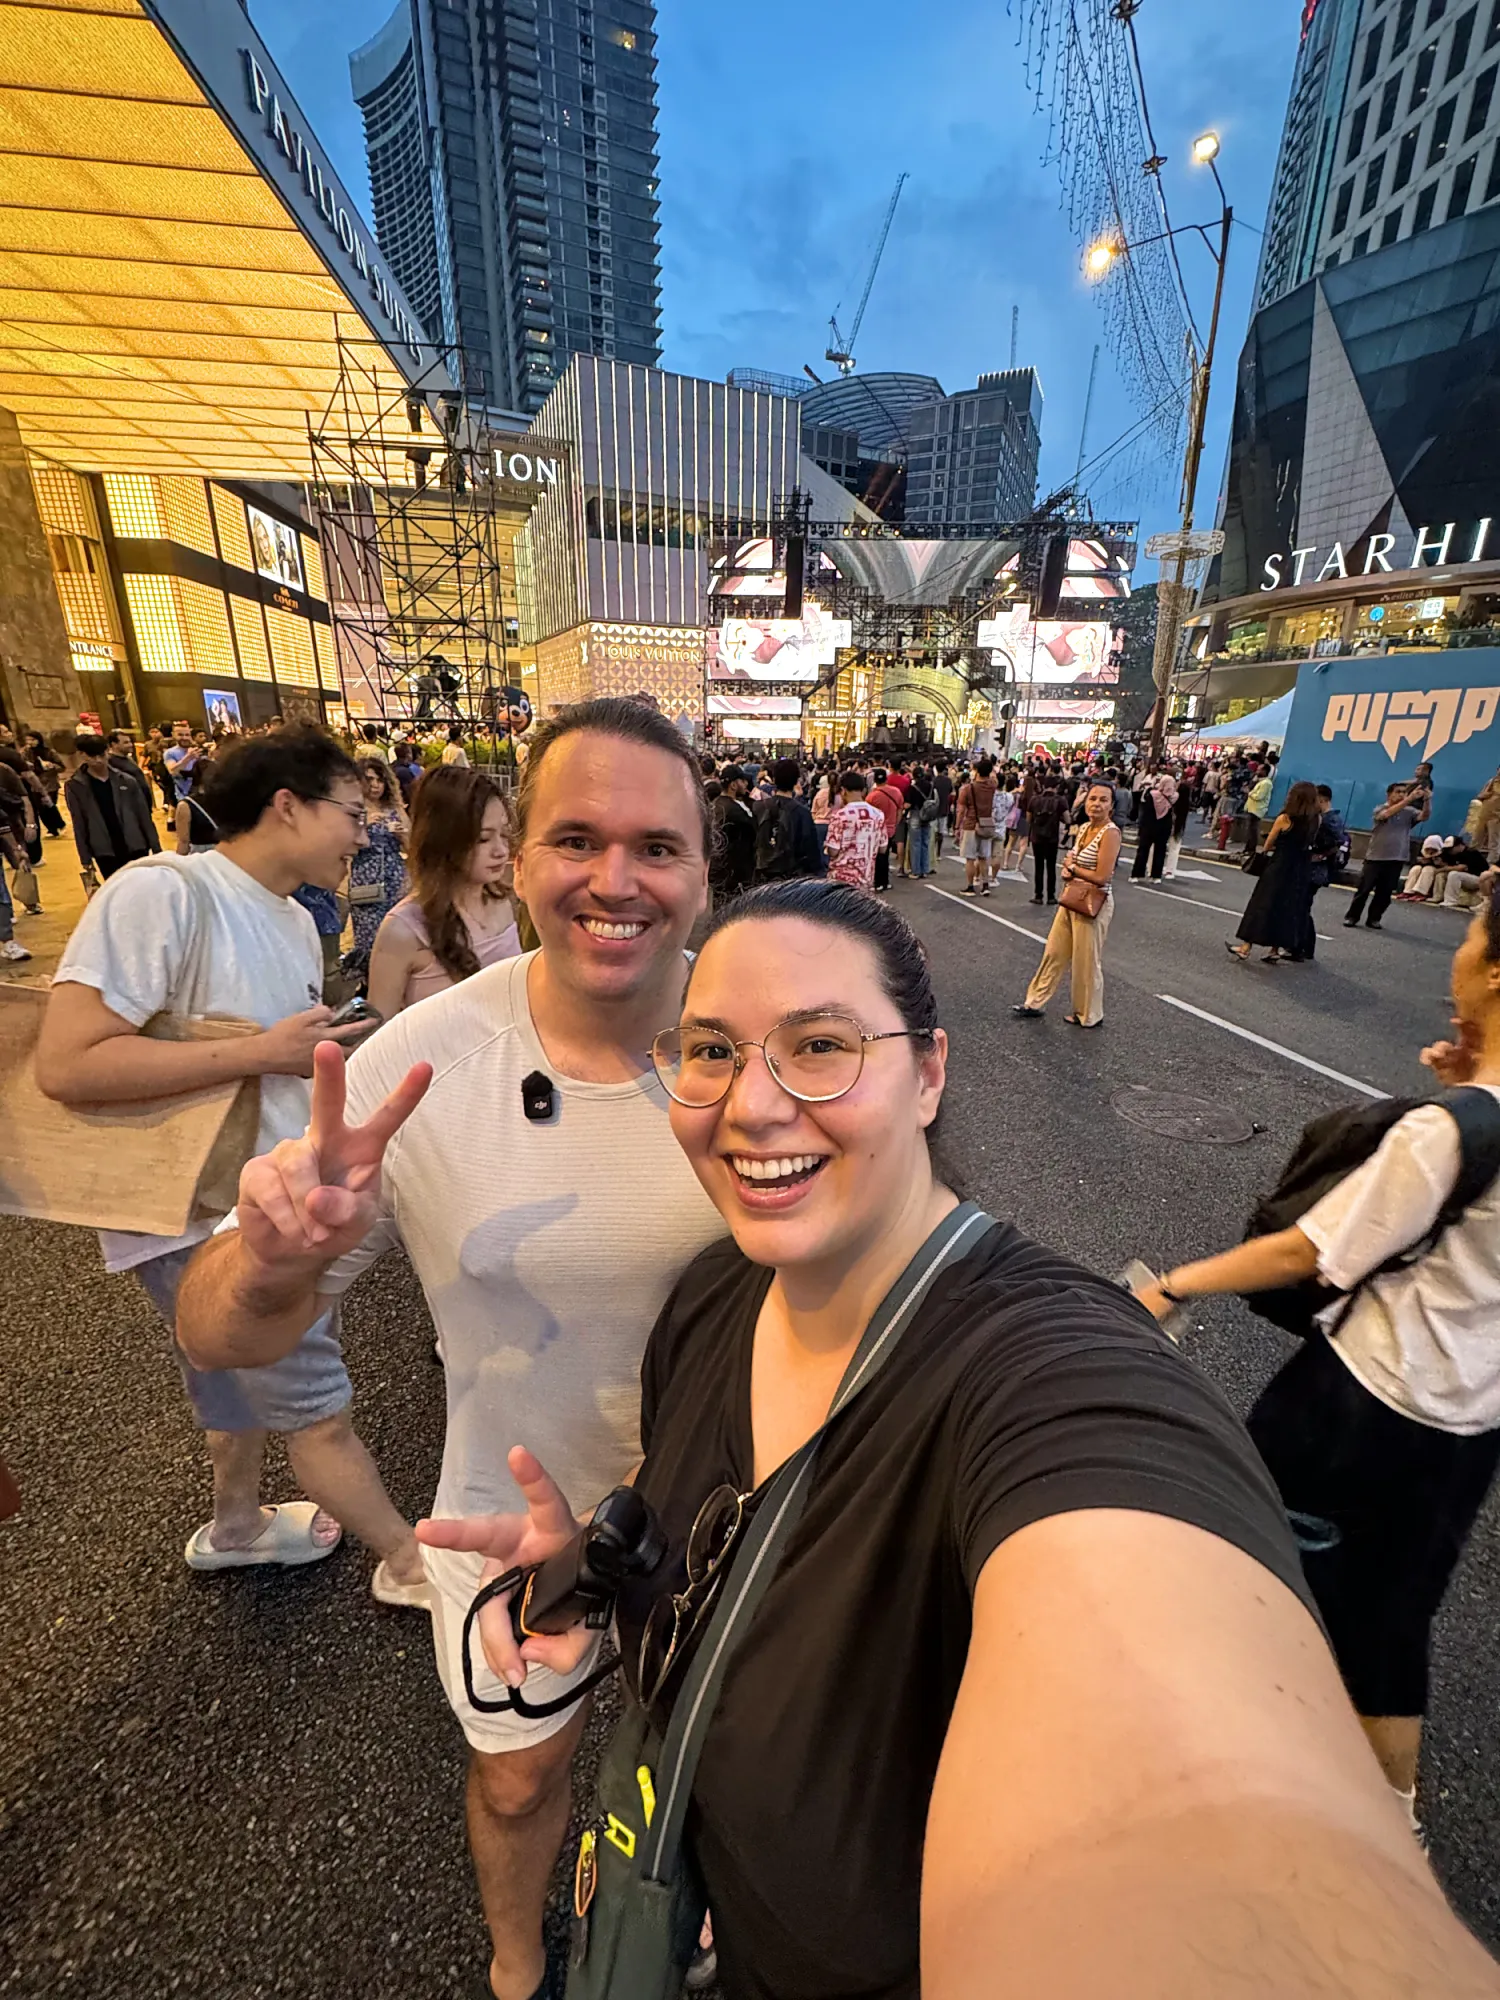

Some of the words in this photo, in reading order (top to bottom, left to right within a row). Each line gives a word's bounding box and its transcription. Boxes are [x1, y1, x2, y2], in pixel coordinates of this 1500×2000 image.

[245, 48, 369, 280] PAVILION
[371, 263, 424, 367] SUITES
[480, 448, 557, 484] ION
[1260, 517, 1493, 592] STARHI
[601, 644, 641, 660] LOUIS
[645, 646, 700, 662] VUITTON
[1321, 687, 1500, 763] PUMP
